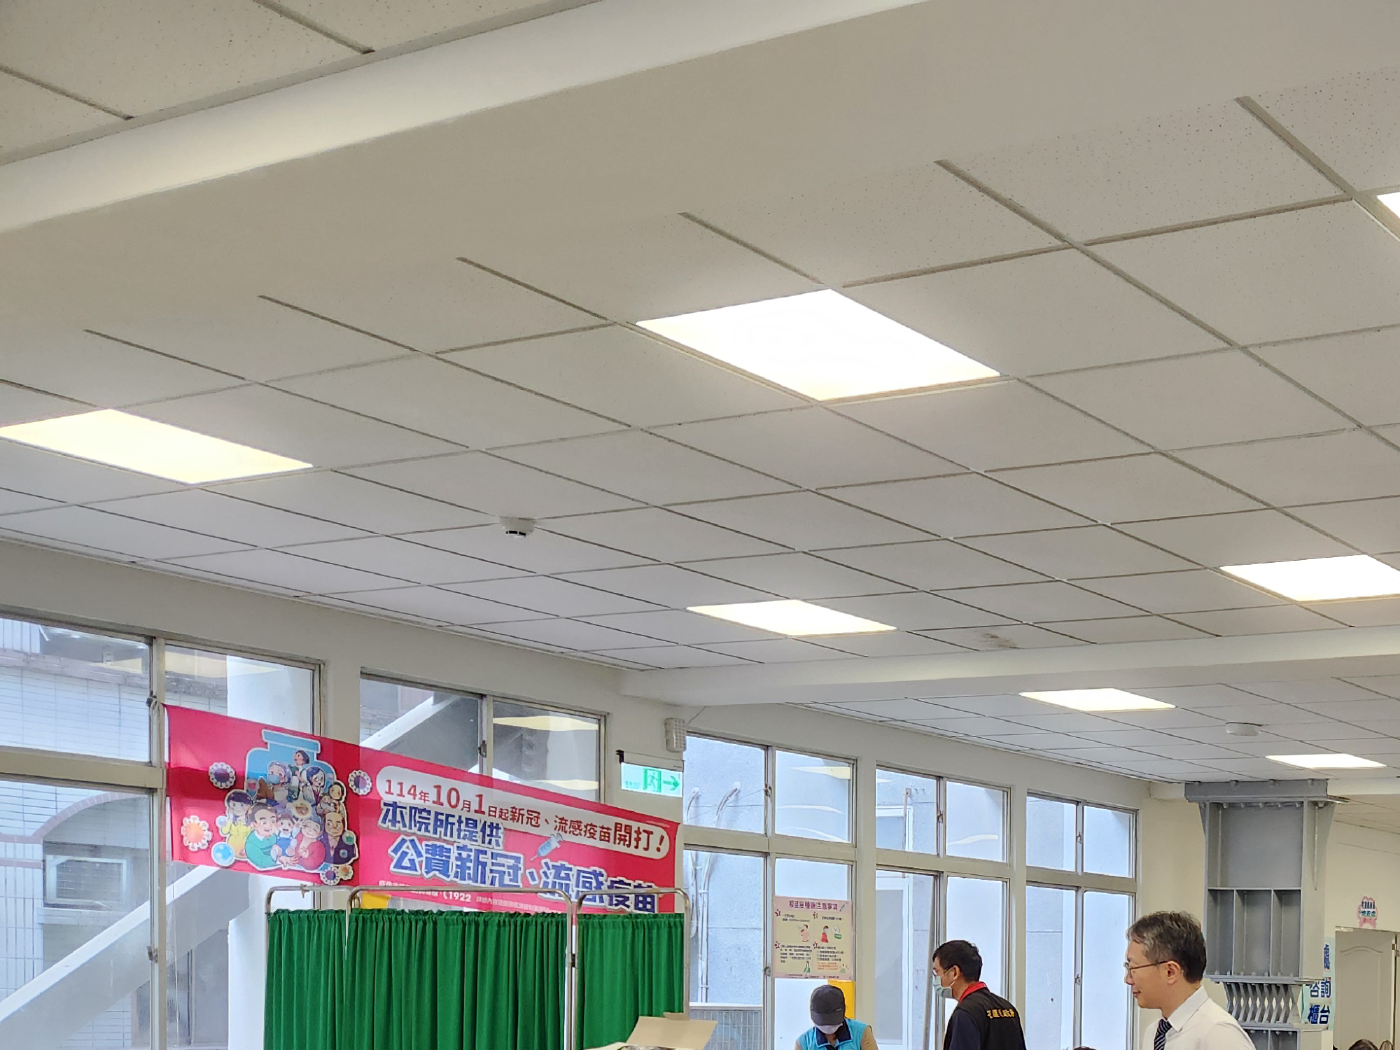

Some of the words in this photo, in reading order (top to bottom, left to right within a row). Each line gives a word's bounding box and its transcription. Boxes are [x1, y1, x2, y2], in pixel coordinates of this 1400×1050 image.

[380, 800, 503, 848] 本院所提供
[389, 835, 657, 914] 公費新冠、流感疫苗
[448, 891, 472, 903] 1922
